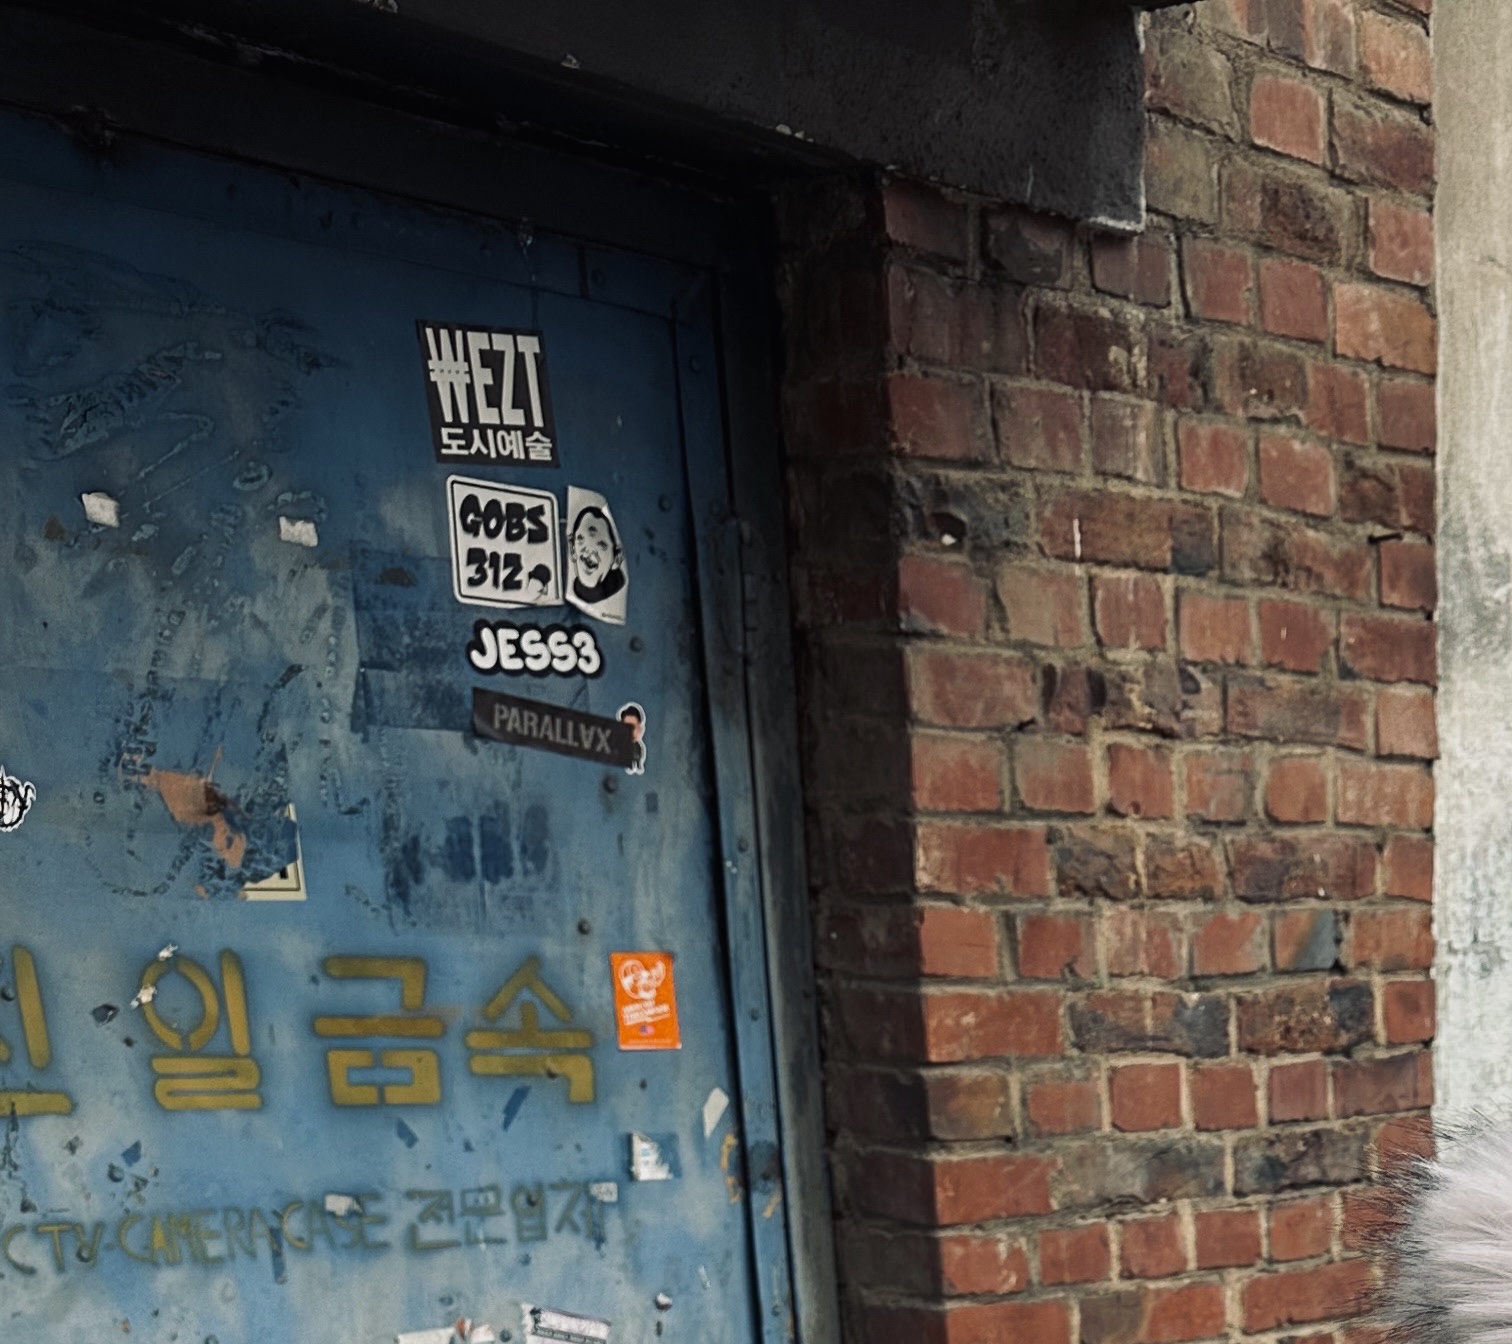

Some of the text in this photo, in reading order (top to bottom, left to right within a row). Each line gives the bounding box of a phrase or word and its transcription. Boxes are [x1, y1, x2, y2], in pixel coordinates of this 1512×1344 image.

[440, 427, 552, 461] 도시예술
[460, 494, 549, 544] GOBS
[466, 547, 523, 591] 312
[470, 627, 601, 674] JESS3
